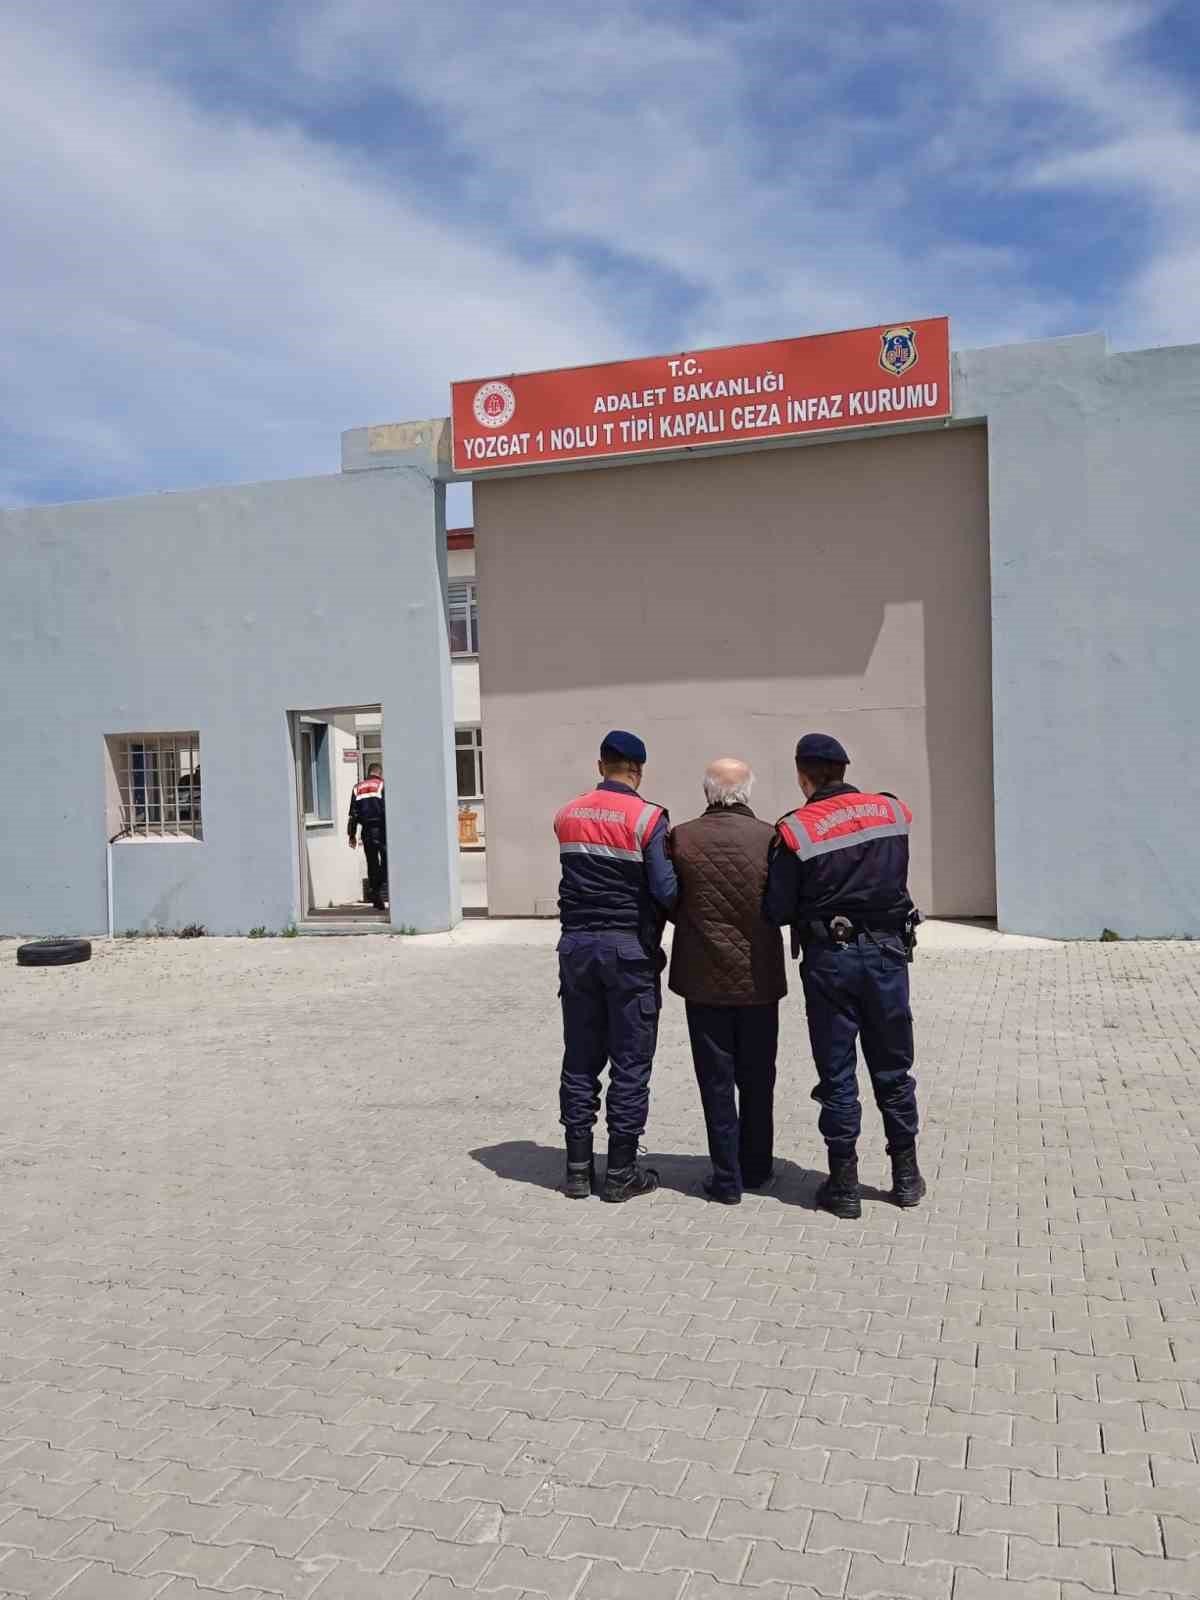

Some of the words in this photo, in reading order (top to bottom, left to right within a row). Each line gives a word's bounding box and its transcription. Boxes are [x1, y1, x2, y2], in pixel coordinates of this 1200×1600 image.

[668, 358, 702, 377] T.C.
[594, 388, 666, 413] ADALET
[673, 370, 784, 403] BAKANLIĞI
[463, 432, 530, 460] YOZGAT
[535, 431, 544, 452] 1
[551, 425, 597, 450] NOLU
[603, 423, 614, 444] T
[620, 412, 654, 443] TİPİ
[659, 409, 724, 439] KAPALI
[731, 403, 781, 430] CEZA
[787, 395, 843, 424] İNFAZ
[849, 382, 937, 416] KURUMU
